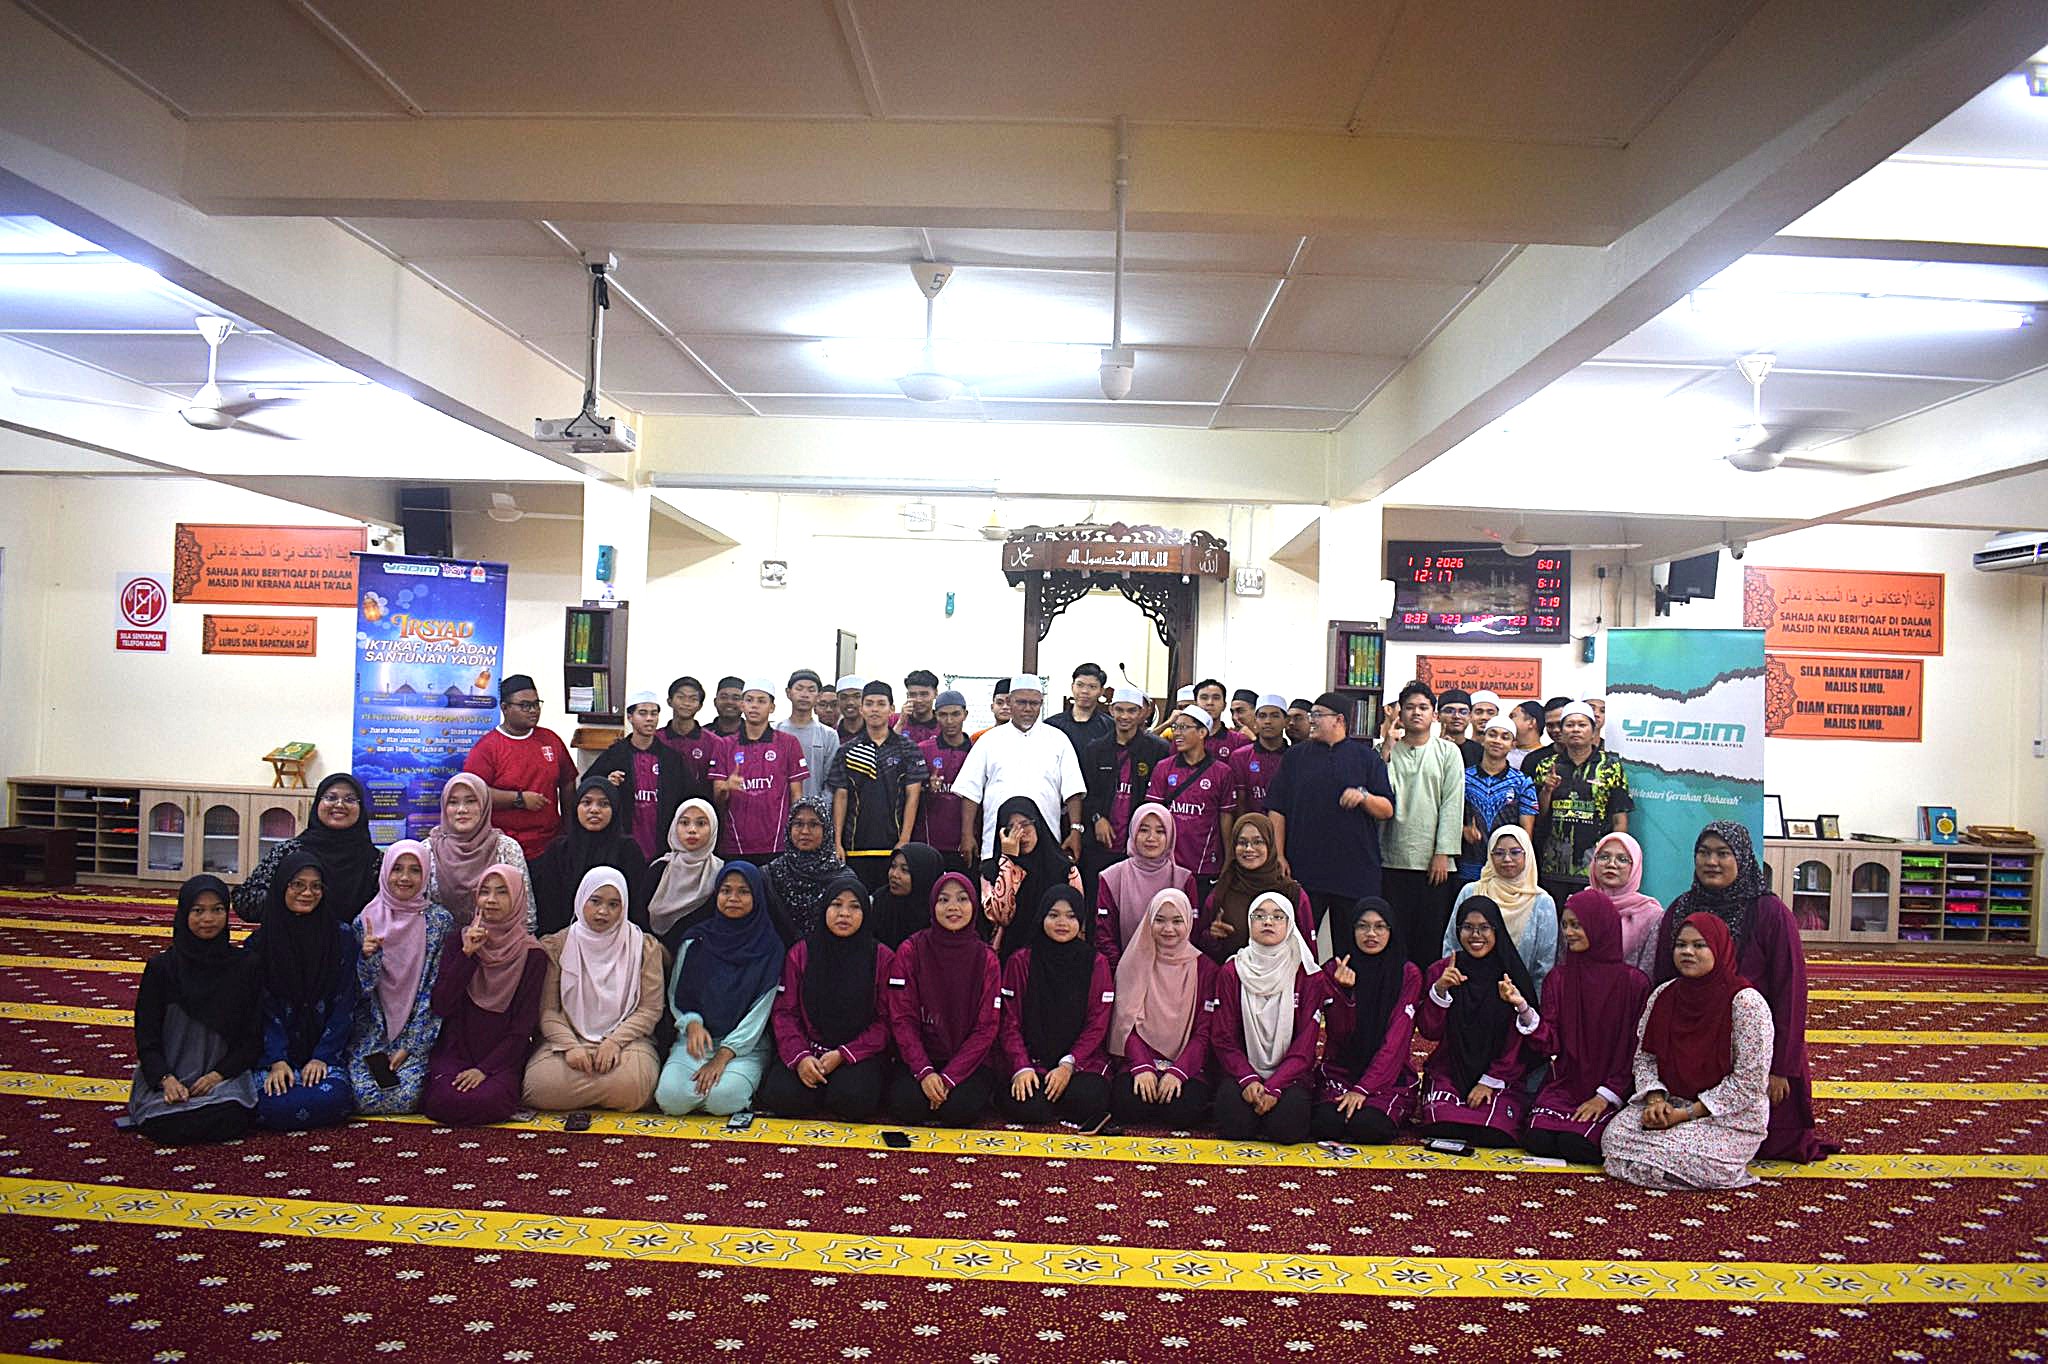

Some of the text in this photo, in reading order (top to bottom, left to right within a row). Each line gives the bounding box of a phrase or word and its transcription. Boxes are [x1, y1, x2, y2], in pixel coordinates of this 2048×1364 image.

[1409, 557, 1464, 568] 1 3 2026
[1537, 559, 1560, 570] 6:01
[206, 567, 238, 577] SAHAJA
[241, 568, 259, 577] AKU
[310, 569, 319, 578] DI
[321, 569, 352, 579] DALAM
[1414, 569, 1453, 582] 12:17
[208, 578, 239, 588] MASJID
[242, 579, 254, 588] INI
[257, 579, 291, 589] KERANA
[293, 580, 320, 589] ALLAH
[1537, 578, 1560, 589] 6:11
[1538, 597, 1560, 608] 7:19
[1404, 613, 1428, 624] 8:33
[1439, 614, 1461, 624] 7:23
[1538, 616, 1560, 626] 7:51
[1780, 612, 1932, 626] SAHAJA AKU BERI'TIQAF DI DALAM
[391, 614, 474, 645] IRSYAD
[1782, 623, 1932, 638] MASJID INI KERANA ALLAH TA'ALA
[218, 638, 309, 648] LURUS DAN RAPATKAN SAF
[365, 639, 497, 655] IKTIKAF RAMADAN
[365, 651, 497, 666] SANTUNAN YADIM
[1800, 665, 1910, 680] SILA RAIKAN KHUTBAH /
[1435, 680, 1533, 691] LURUS DAN RAPATKAN SAF
[1825, 681, 1885, 694] MAJLIS ILMU.
[1796, 700, 1912, 717] DIAM KETIKA KHUTBAH /
[1824, 718, 1884, 730] MAJLIS ILMU.
[1169, 799, 1206, 816] AMITY
